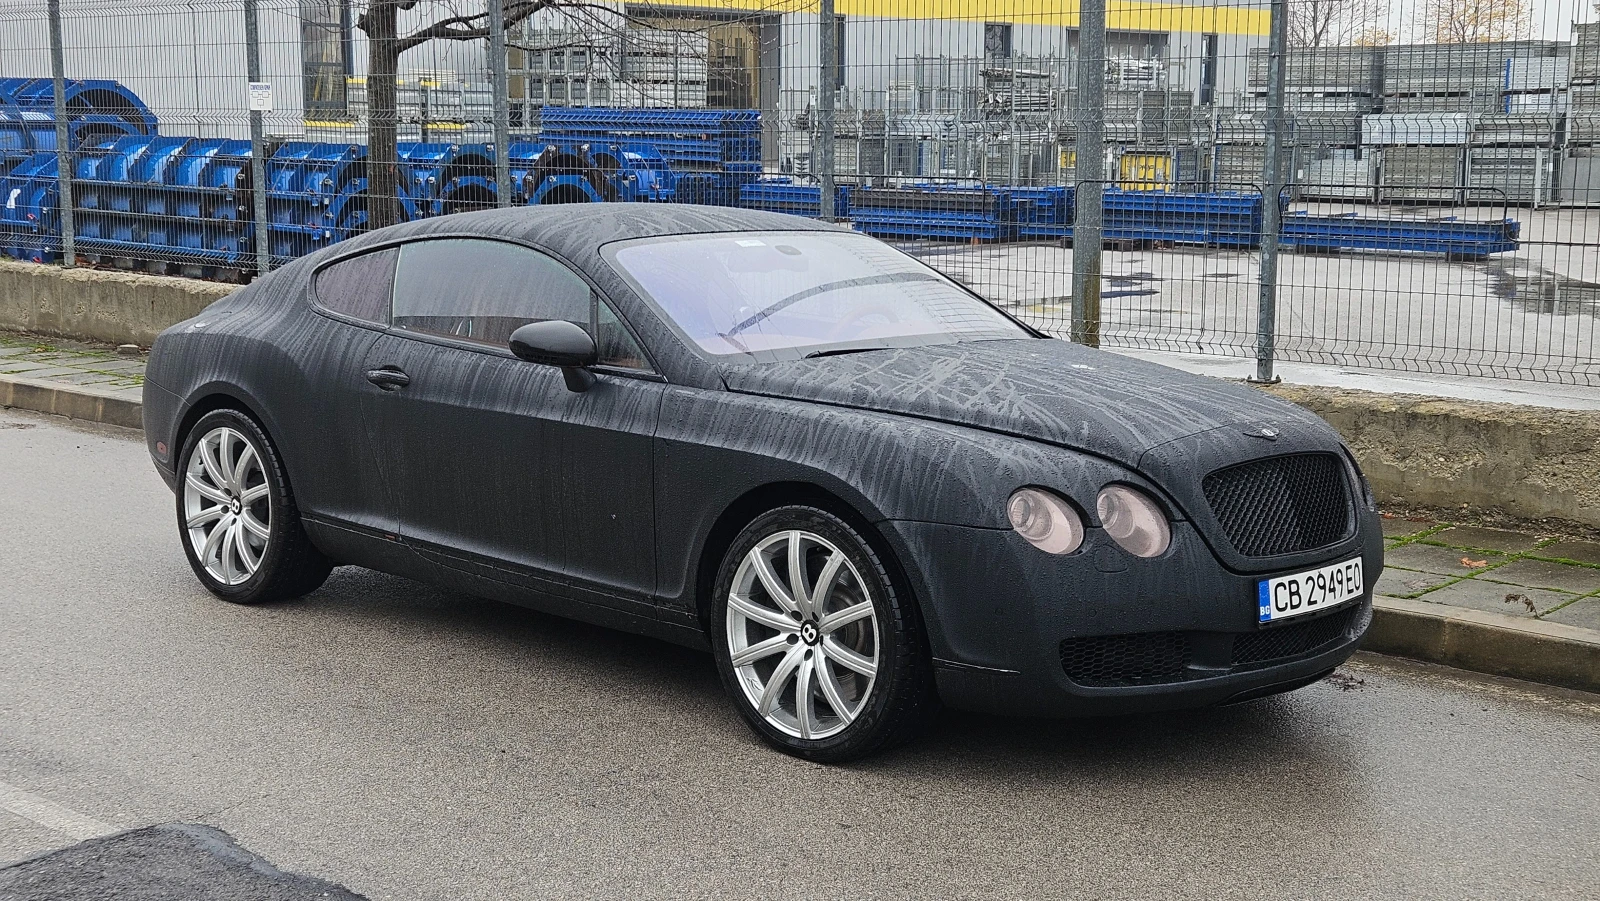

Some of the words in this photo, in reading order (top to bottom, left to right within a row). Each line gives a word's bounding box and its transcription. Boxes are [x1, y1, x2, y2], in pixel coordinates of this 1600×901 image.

[1274, 579, 1302, 612] CB
[1260, 605, 1270, 615] BG
[802, 623, 817, 643] B
